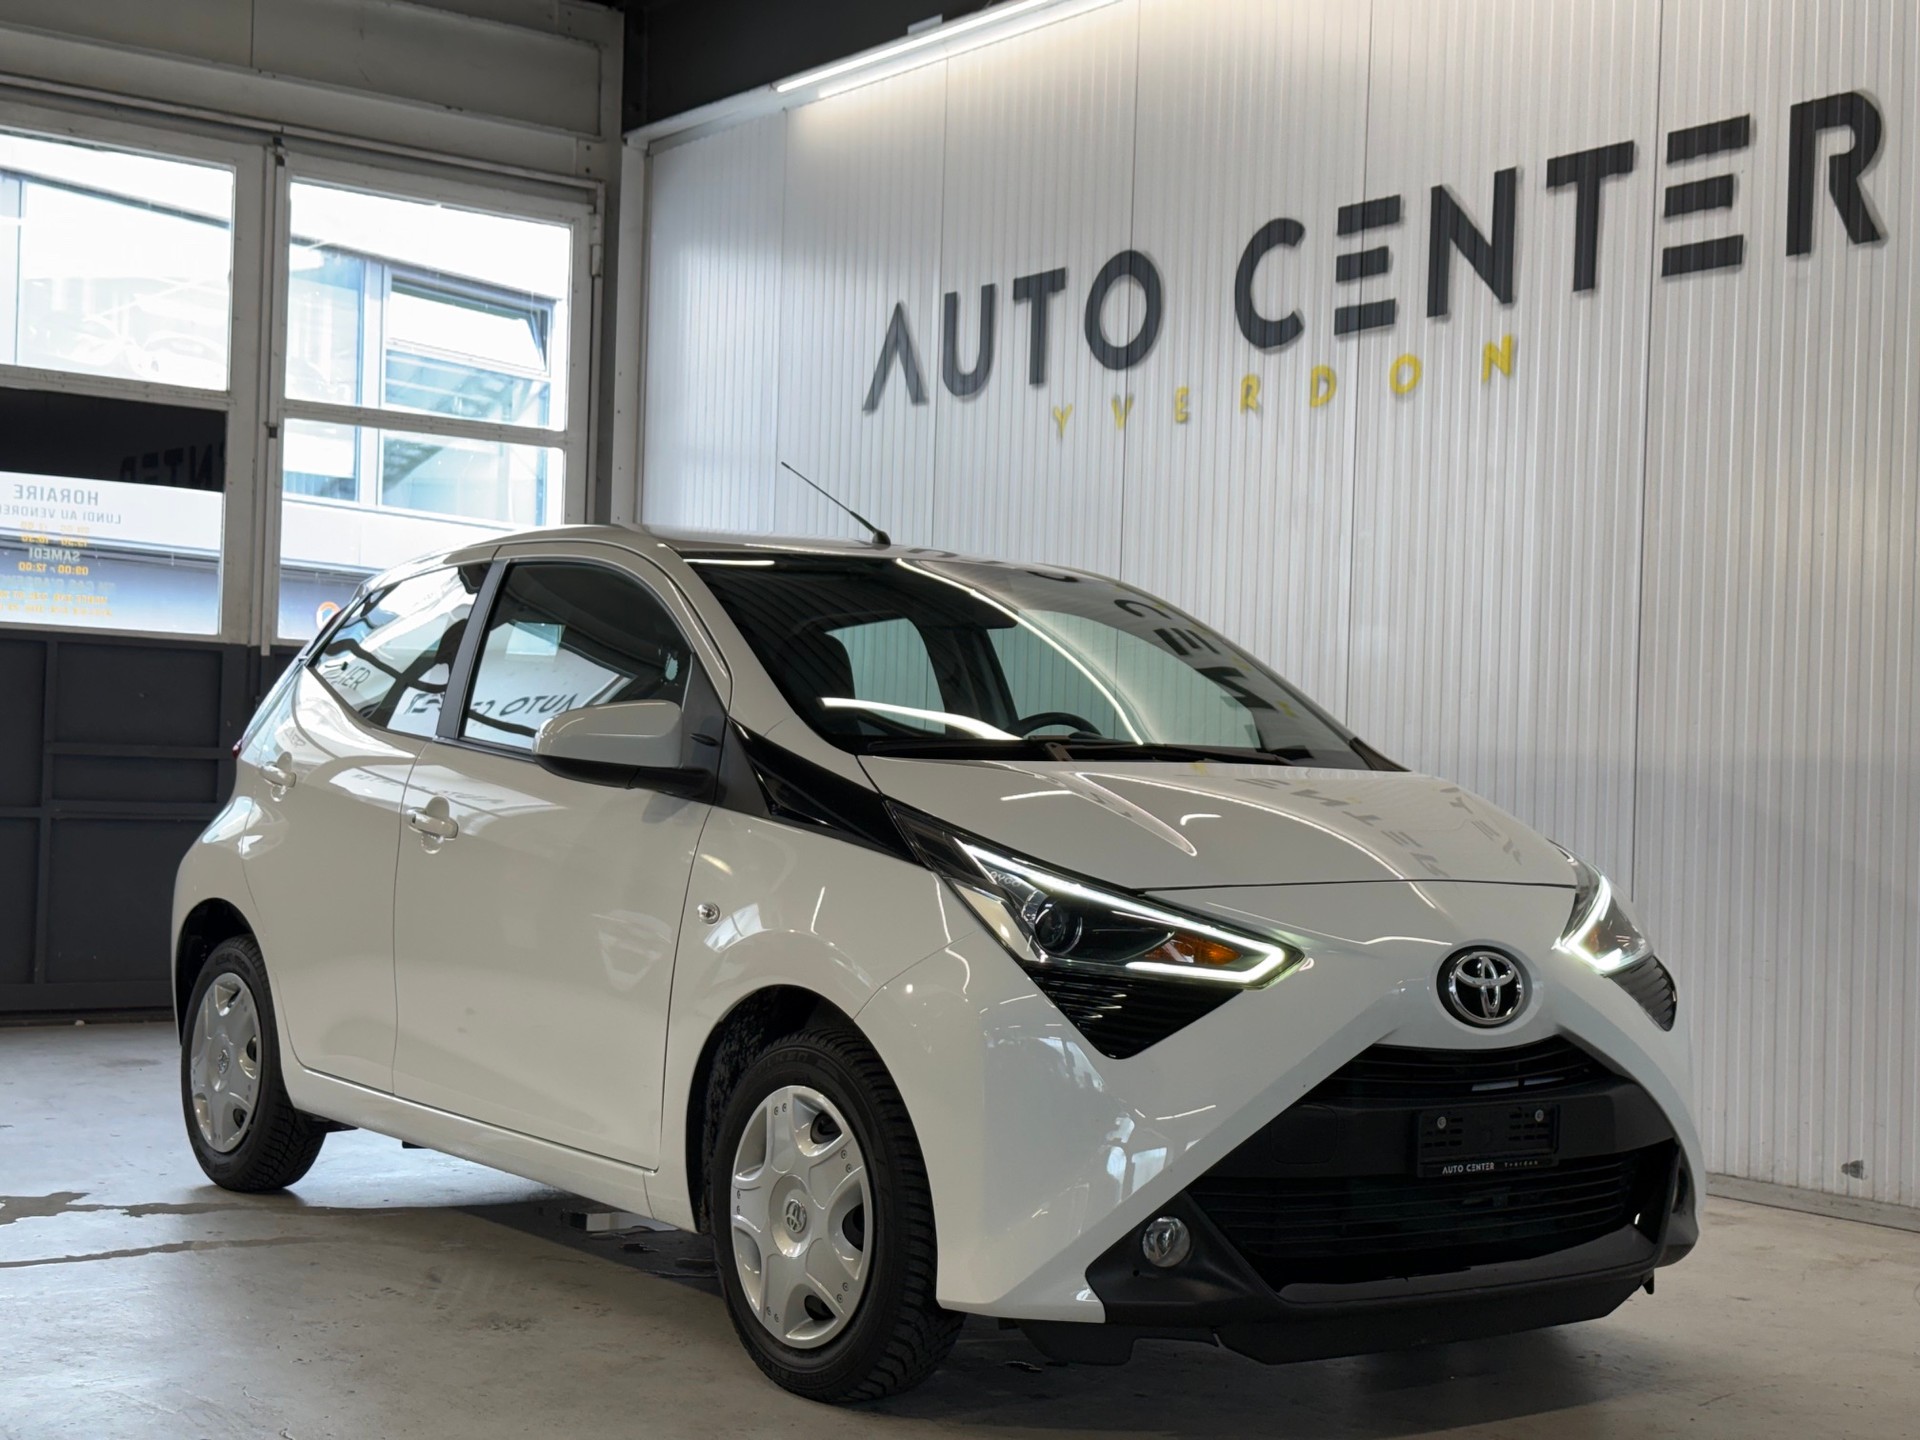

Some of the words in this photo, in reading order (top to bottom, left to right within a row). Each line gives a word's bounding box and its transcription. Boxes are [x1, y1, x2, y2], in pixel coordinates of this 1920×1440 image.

[862, 250, 1164, 414] AUTO
[1235, 91, 1886, 349] CENTER
[1053, 334, 1515, 438] YVERDON
[1442, 1164, 1464, 1175] AUTO
[1465, 1162, 1495, 1172] CENTER
